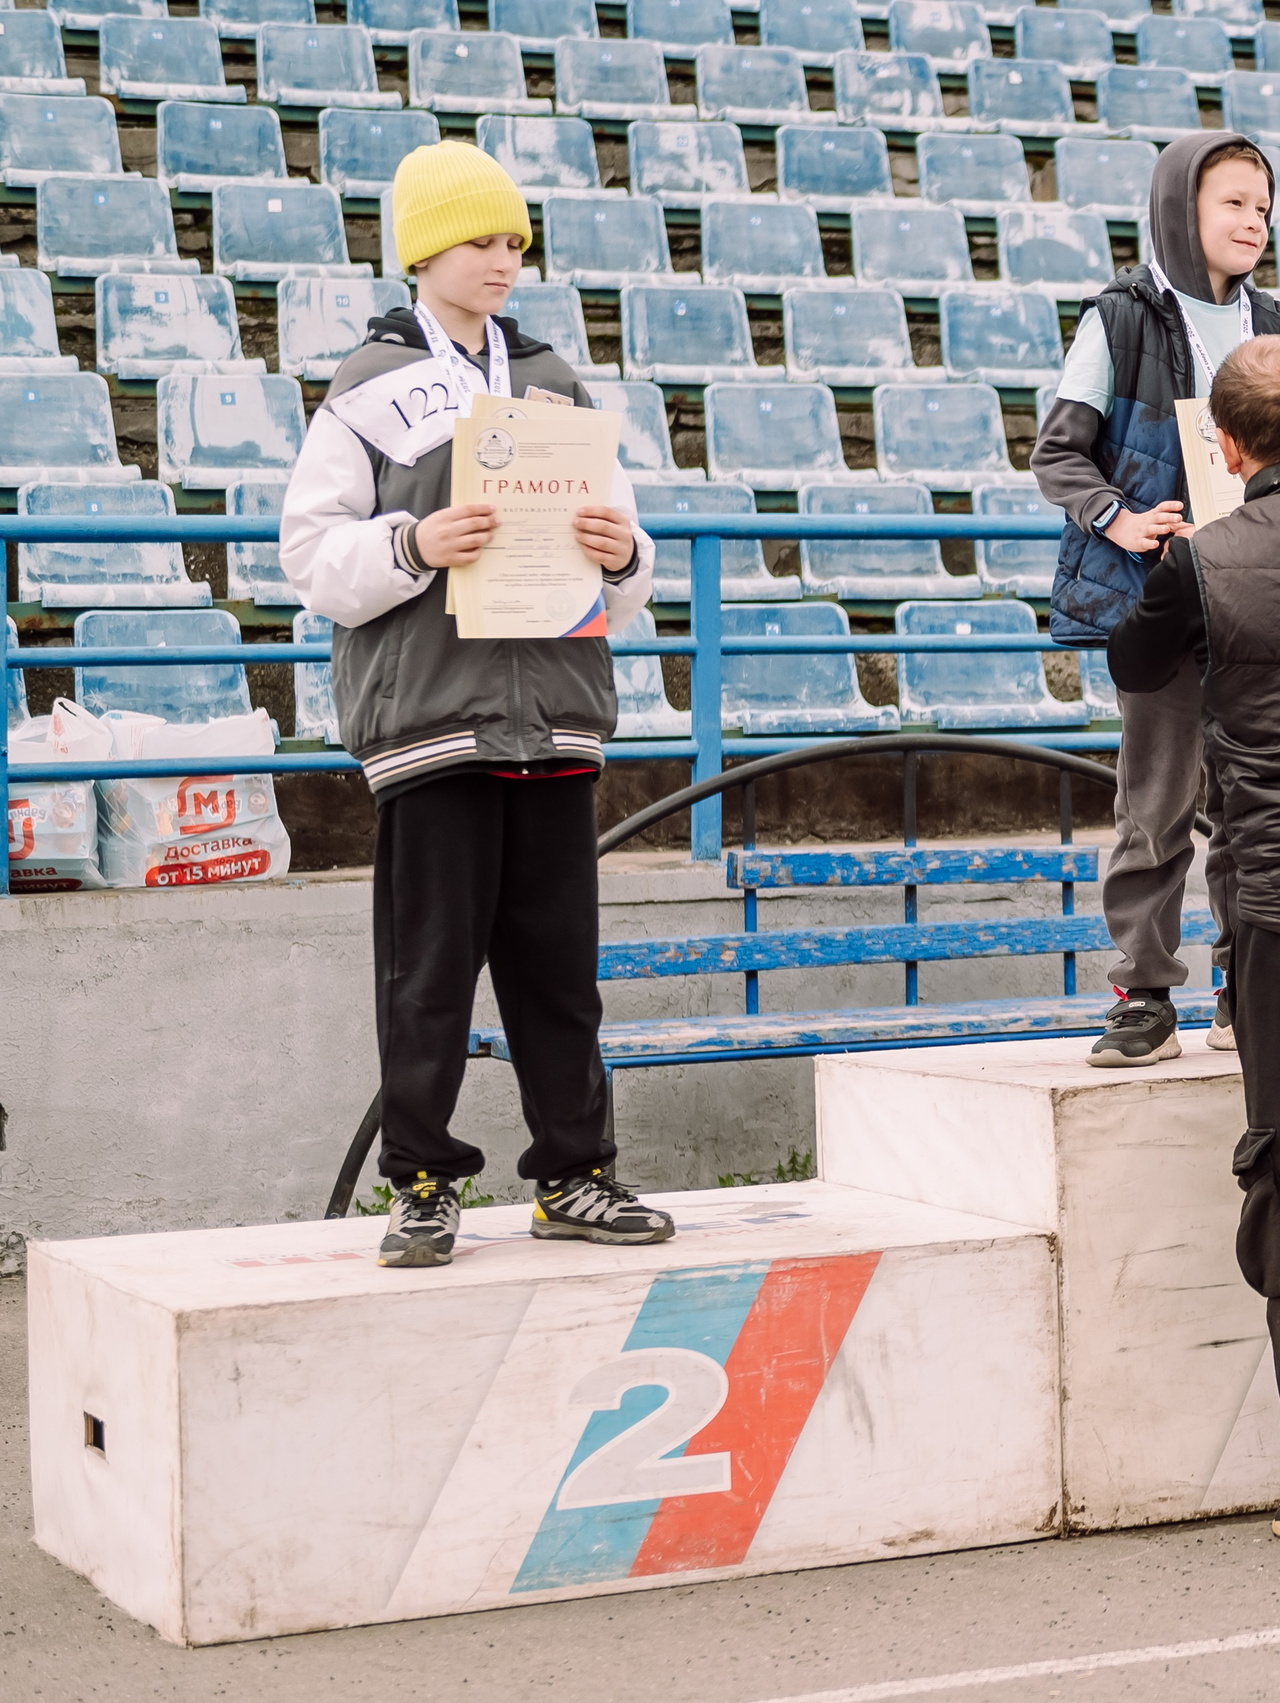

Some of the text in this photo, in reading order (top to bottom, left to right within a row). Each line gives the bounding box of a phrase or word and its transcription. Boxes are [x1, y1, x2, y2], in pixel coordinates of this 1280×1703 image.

[388, 382, 459, 432] 122
[483, 479, 590, 494] ГРАМОТА
[164, 837, 253, 861] Доставка
[9, 866, 58, 878] авка
[157, 871, 179, 885] от
[183, 866, 203, 881] 15
[207, 857, 261, 879] минут
[557, 1348, 732, 1511] 2
